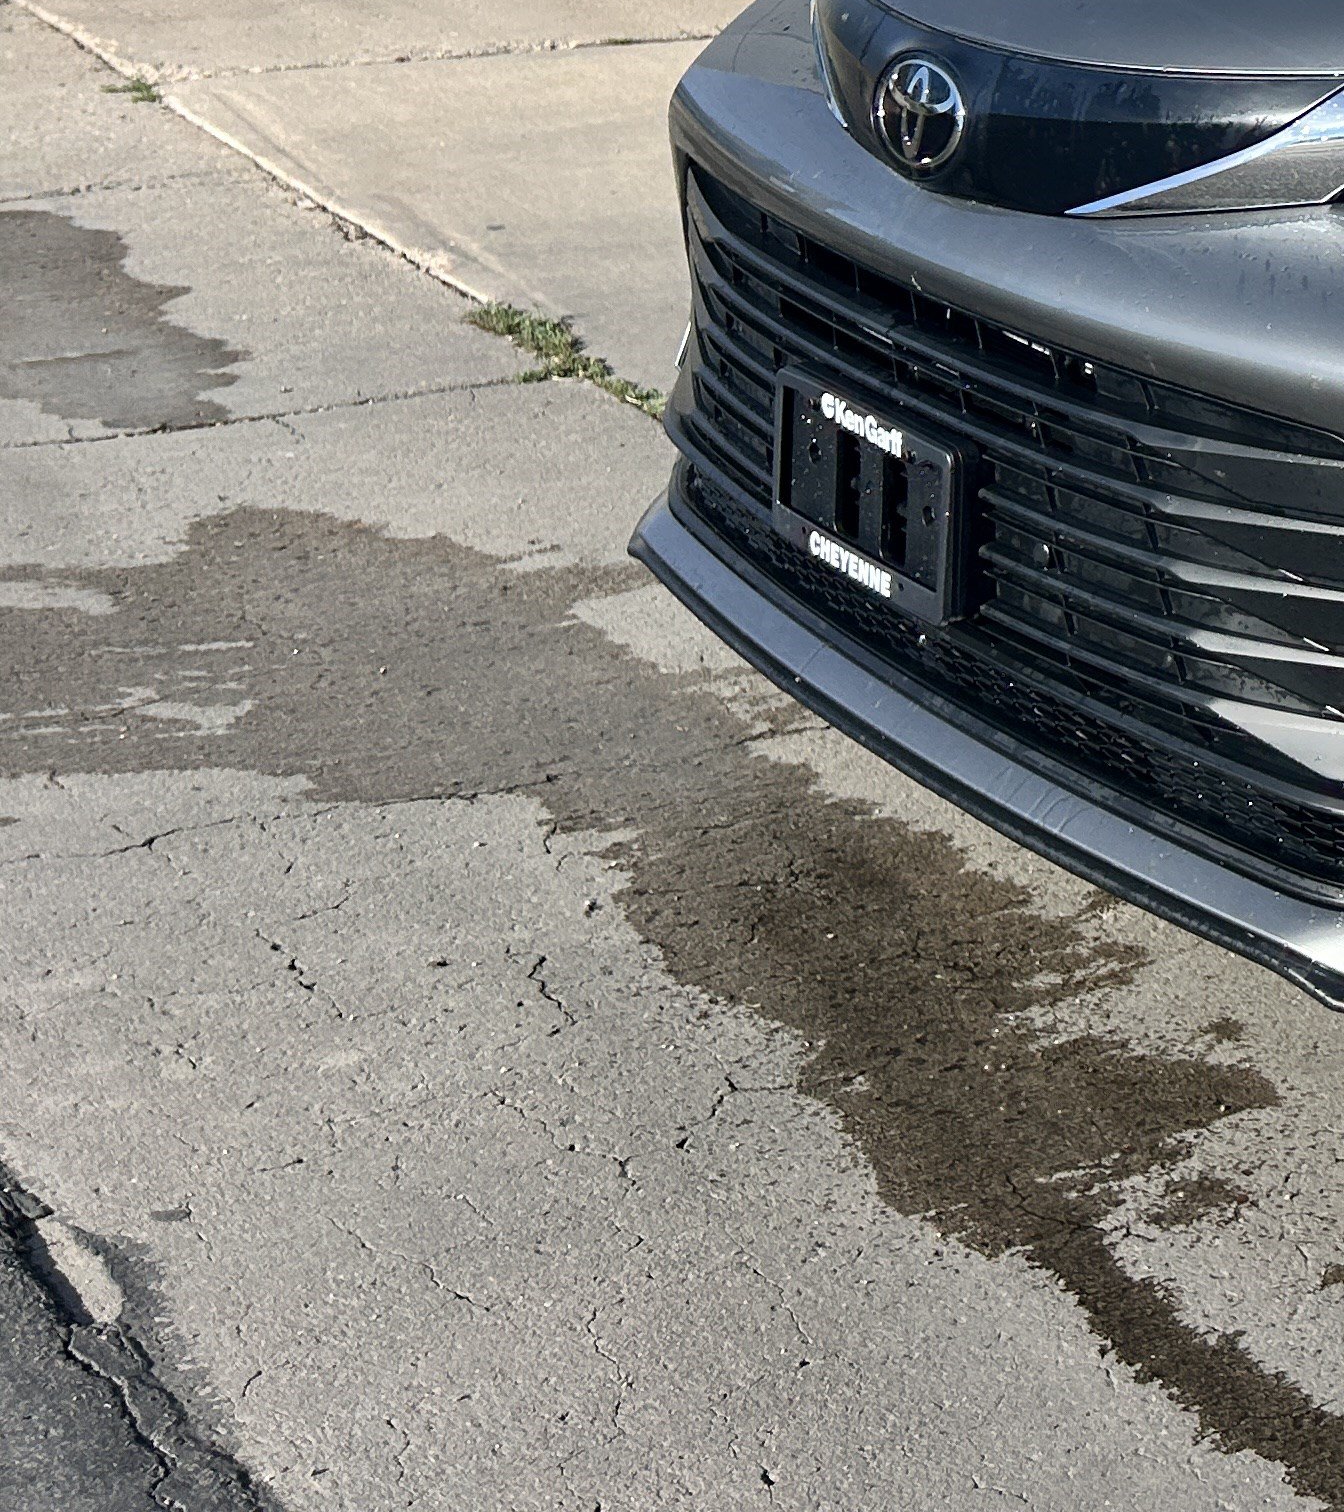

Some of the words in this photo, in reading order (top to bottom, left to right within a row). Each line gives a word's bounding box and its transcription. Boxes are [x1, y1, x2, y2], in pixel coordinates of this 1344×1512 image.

[834, 400, 866, 438] Ken
[864, 414, 903, 458] Garff
[809, 530, 892, 599] CHEYENNE
